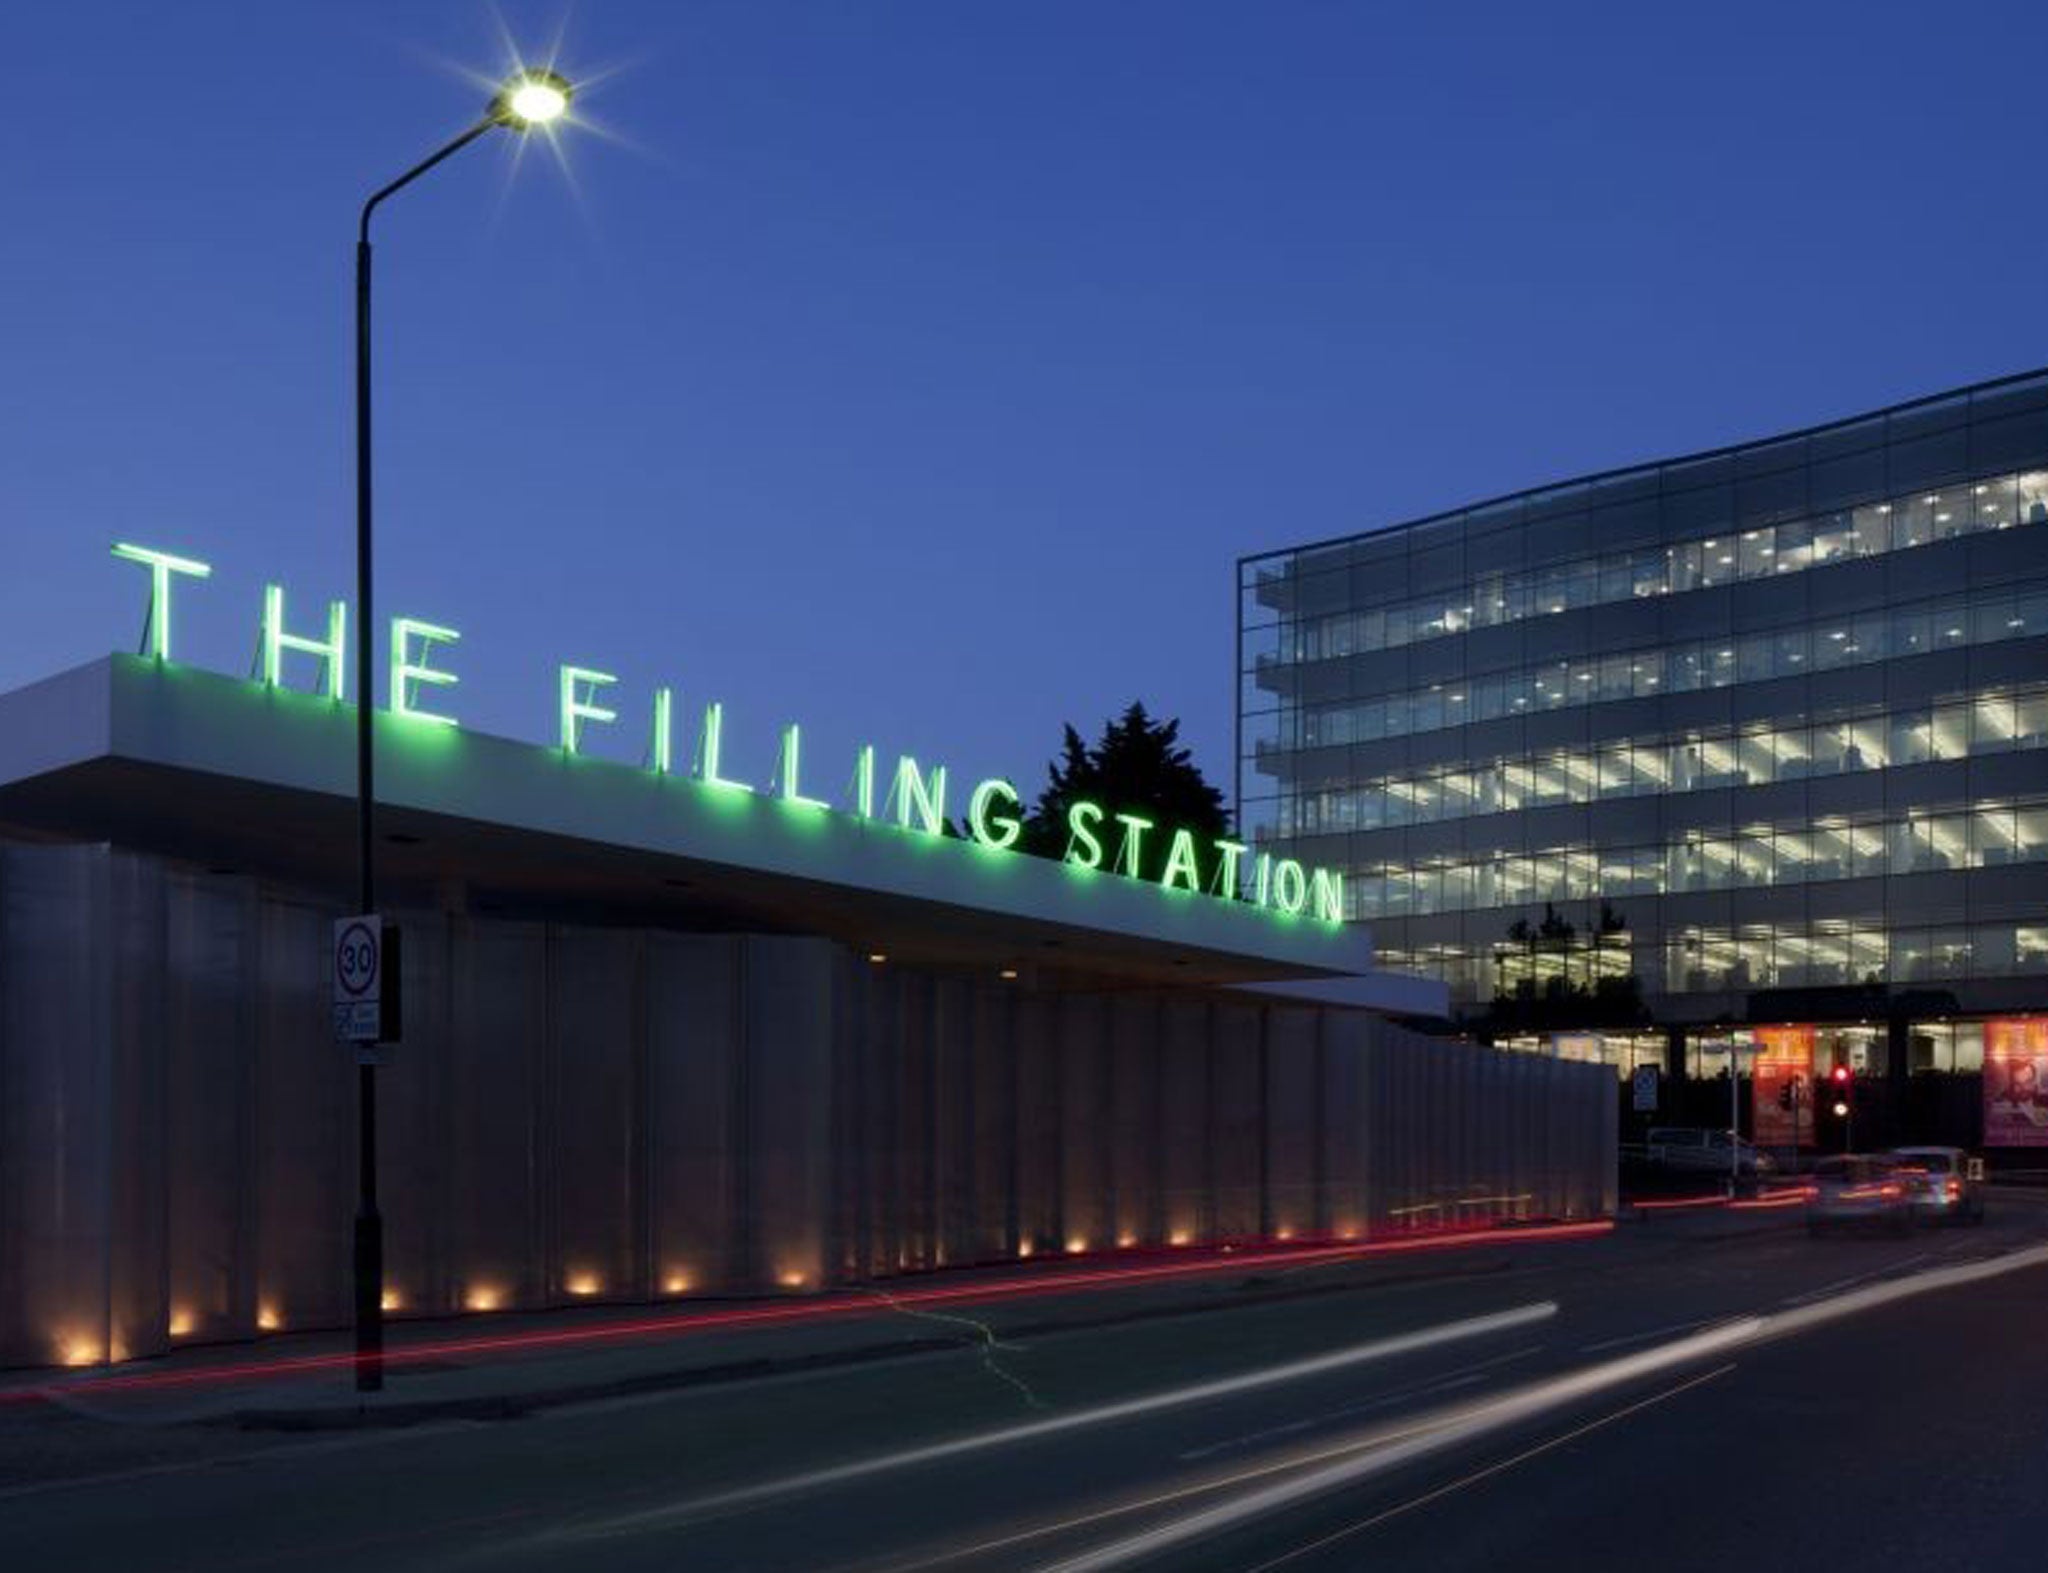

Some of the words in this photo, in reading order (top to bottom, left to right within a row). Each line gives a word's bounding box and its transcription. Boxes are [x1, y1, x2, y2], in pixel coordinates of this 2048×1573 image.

[111, 542, 461, 727] THE
[559, 664, 1021, 851] FILLING
[1067, 801, 1345, 926] STATION
[343, 942, 371, 975] 30
